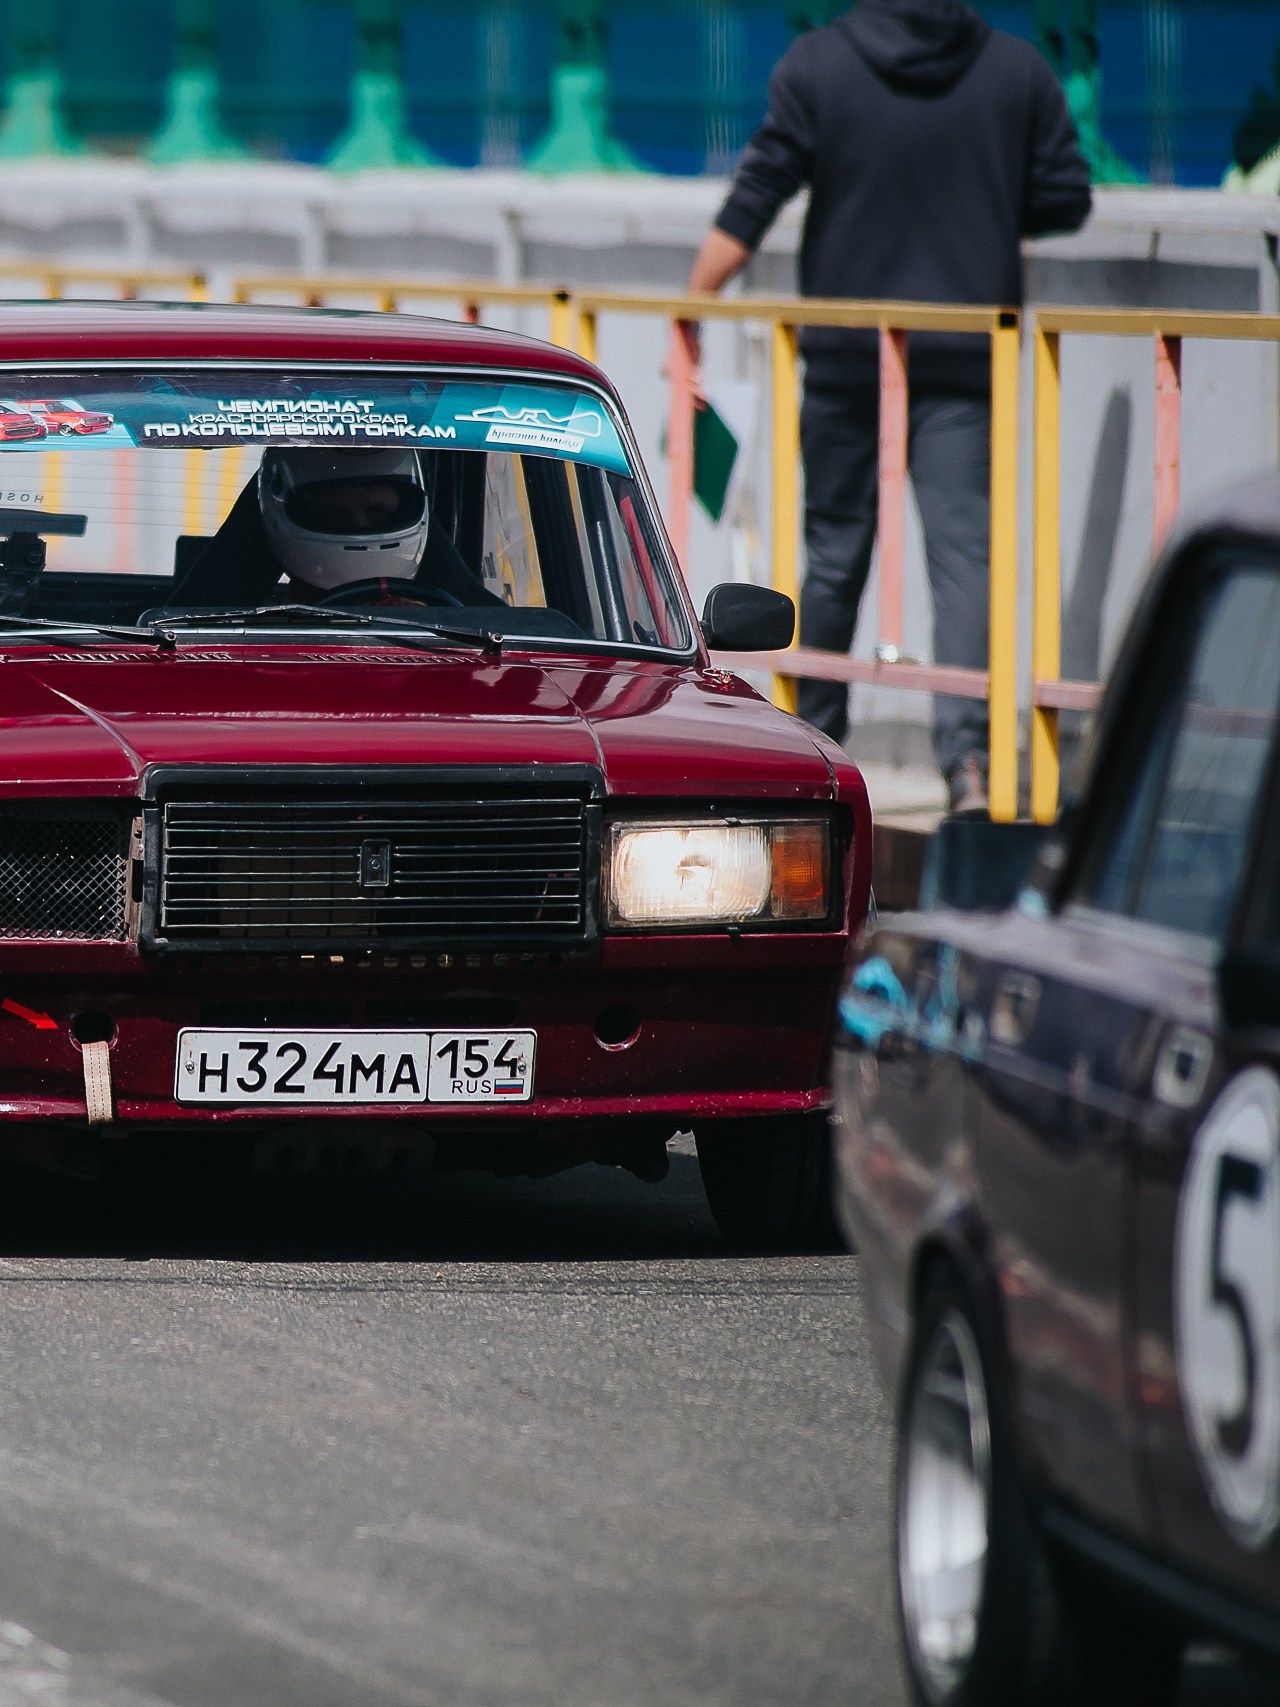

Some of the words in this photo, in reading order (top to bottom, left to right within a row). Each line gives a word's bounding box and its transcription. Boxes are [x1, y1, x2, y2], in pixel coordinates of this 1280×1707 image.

[217, 399, 374, 413] ЧЕМПИОНАТ
[188, 412, 355, 424] КРАСНОЯРСКОГО
[356, 413, 408, 424] КРАЯ
[143, 423, 181, 437] ПО
[181, 422, 345, 437] КОЛЬЦЕВЫМ
[348, 423, 457, 439] ГОНКАМ
[436, 1039, 518, 1079] 154
[451, 1080, 492, 1094] RUS
[1212, 1153, 1264, 1461] 5
